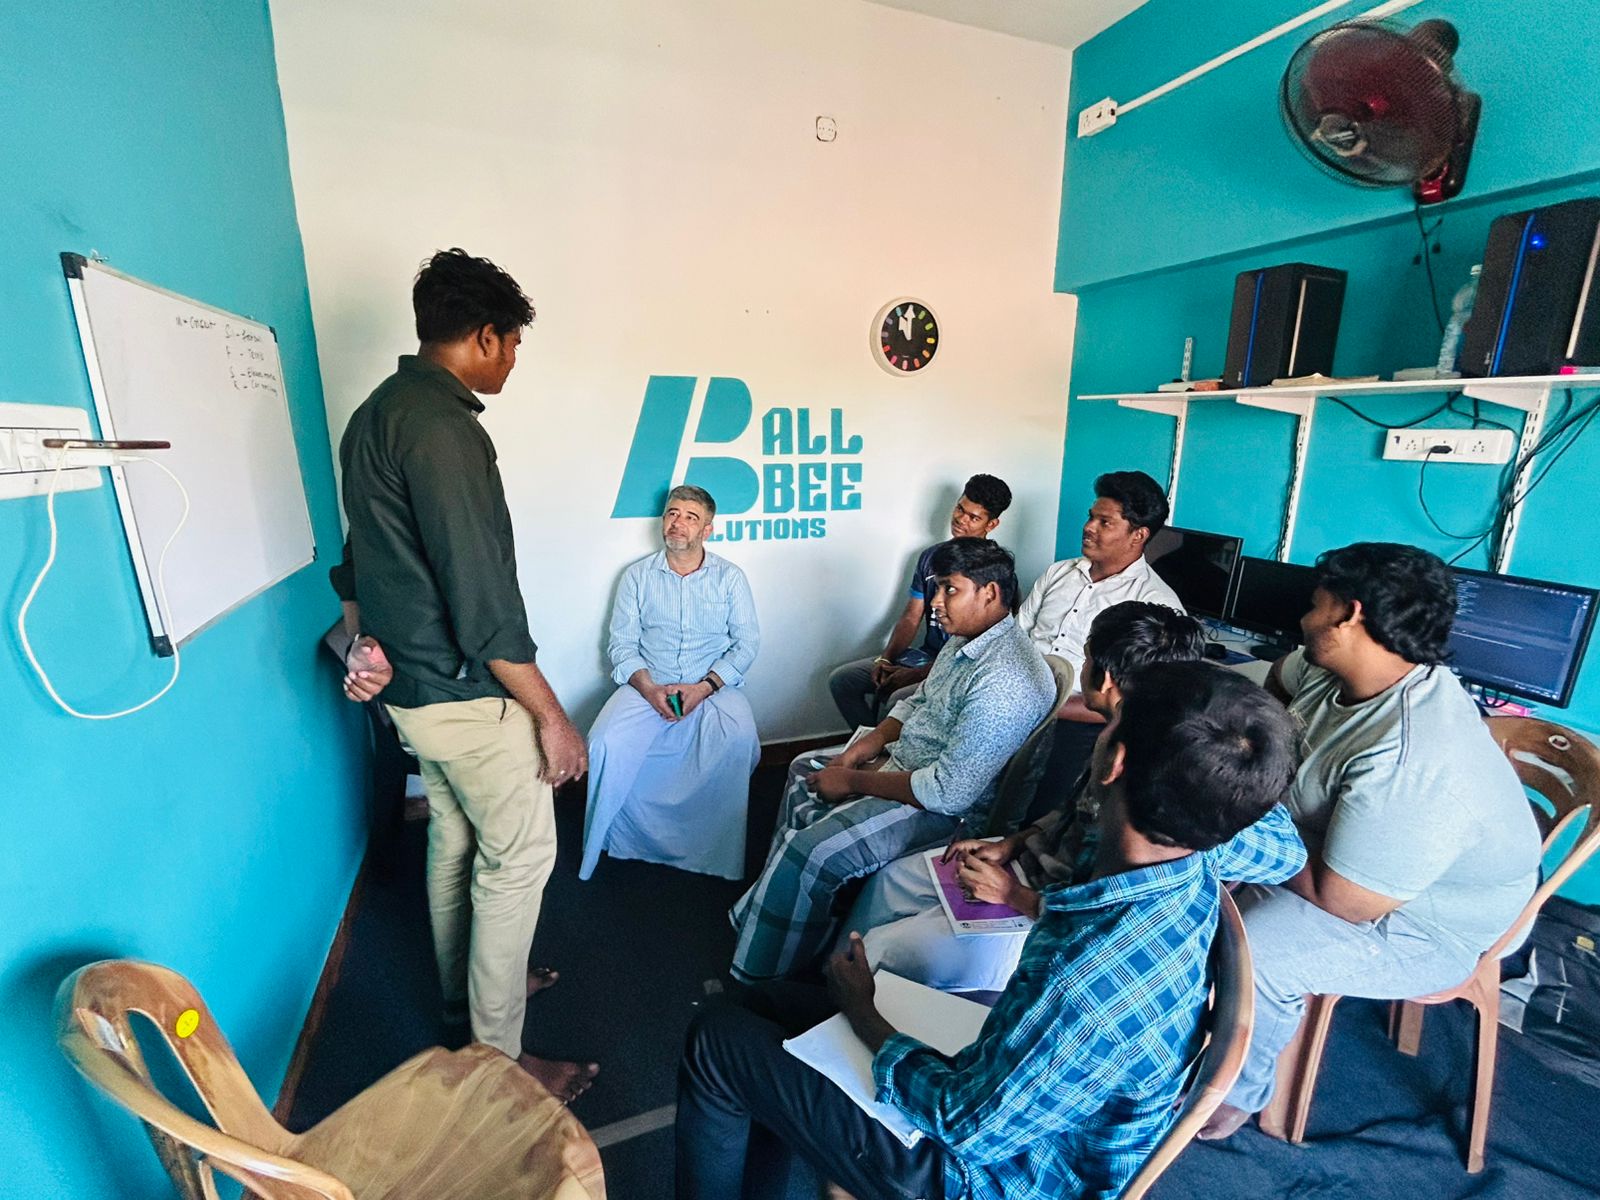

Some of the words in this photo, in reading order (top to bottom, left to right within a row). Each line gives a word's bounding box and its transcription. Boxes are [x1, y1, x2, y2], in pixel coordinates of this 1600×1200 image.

[762, 407, 863, 455] ALL
[763, 462, 863, 513] BEE
[706, 518, 826, 542] LUTIONS
